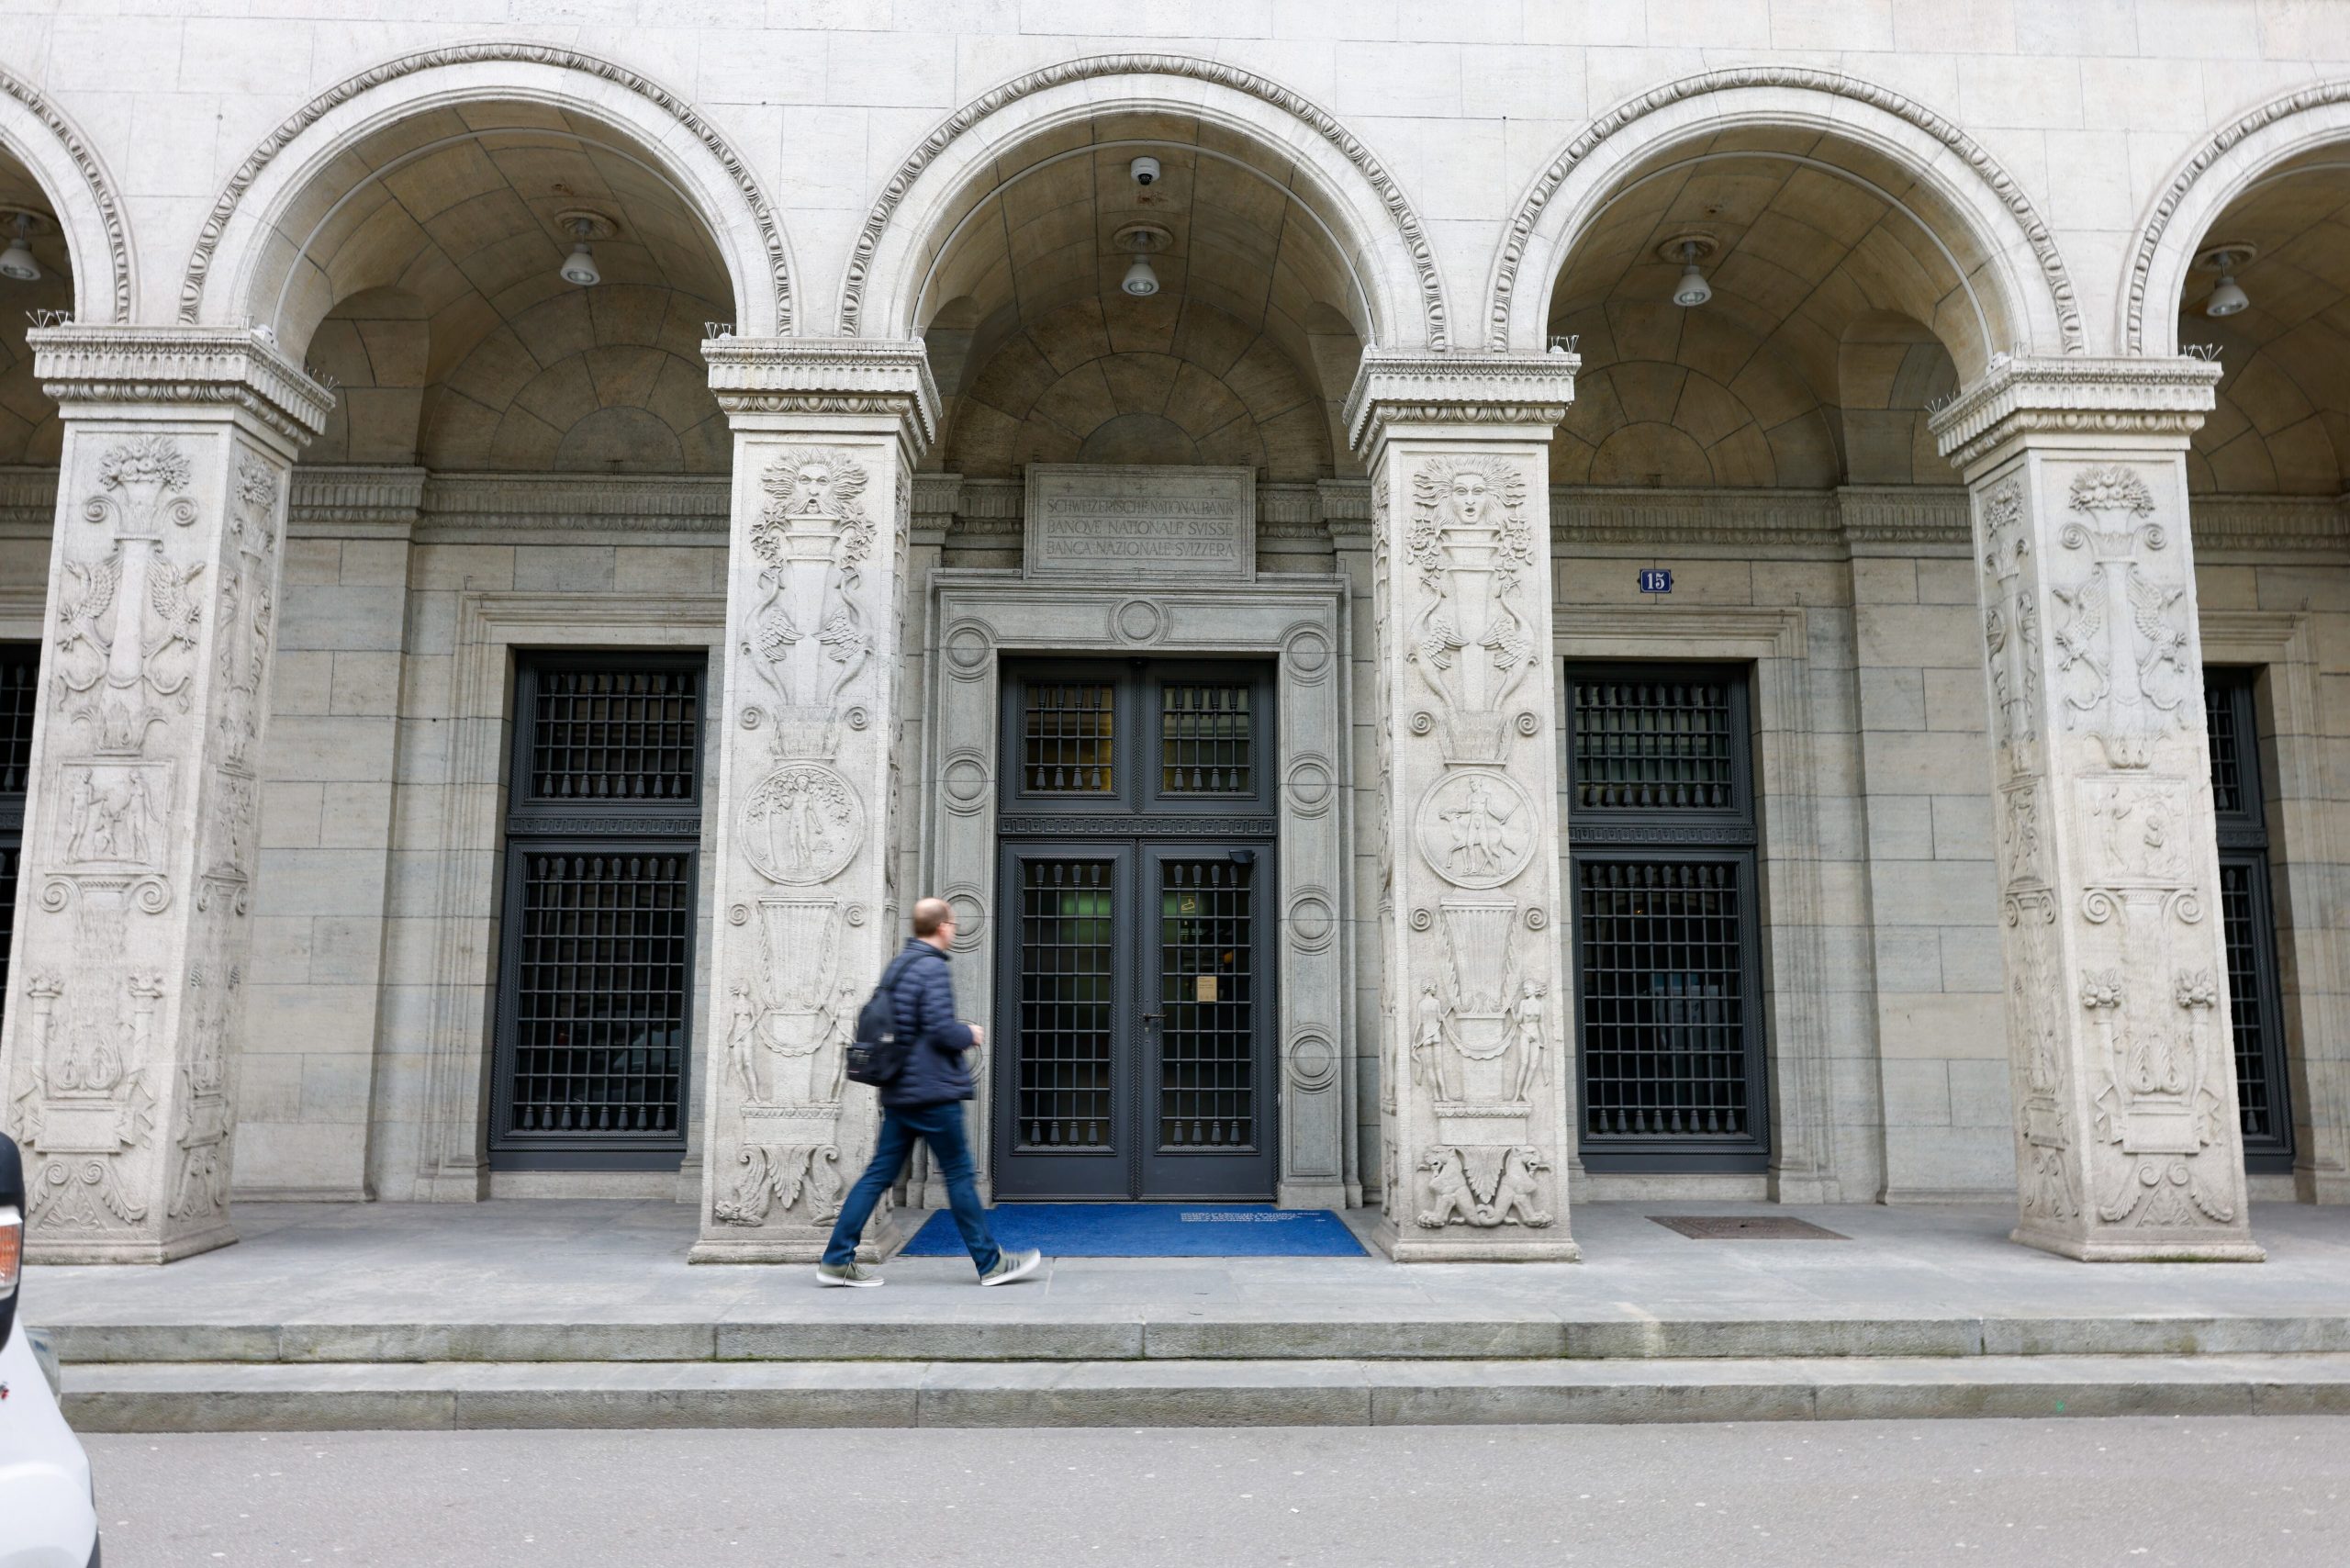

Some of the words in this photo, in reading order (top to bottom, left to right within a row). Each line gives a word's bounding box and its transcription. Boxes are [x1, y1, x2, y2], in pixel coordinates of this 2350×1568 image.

[1046, 498, 1147, 514] SCHWEIZERISCHE
[1150, 499, 1235, 515] NATIONALBANK
[1046, 520, 1102, 535] BANQVE
[1108, 520, 1184, 535] NATIONALE
[1188, 521, 1234, 536] SVISSE
[1046, 541, 1091, 554] BANCA
[1096, 541, 1171, 556] NAZIONALE
[1175, 542, 1237, 557] SVIZZERA
[1647, 572, 1665, 589] 15
